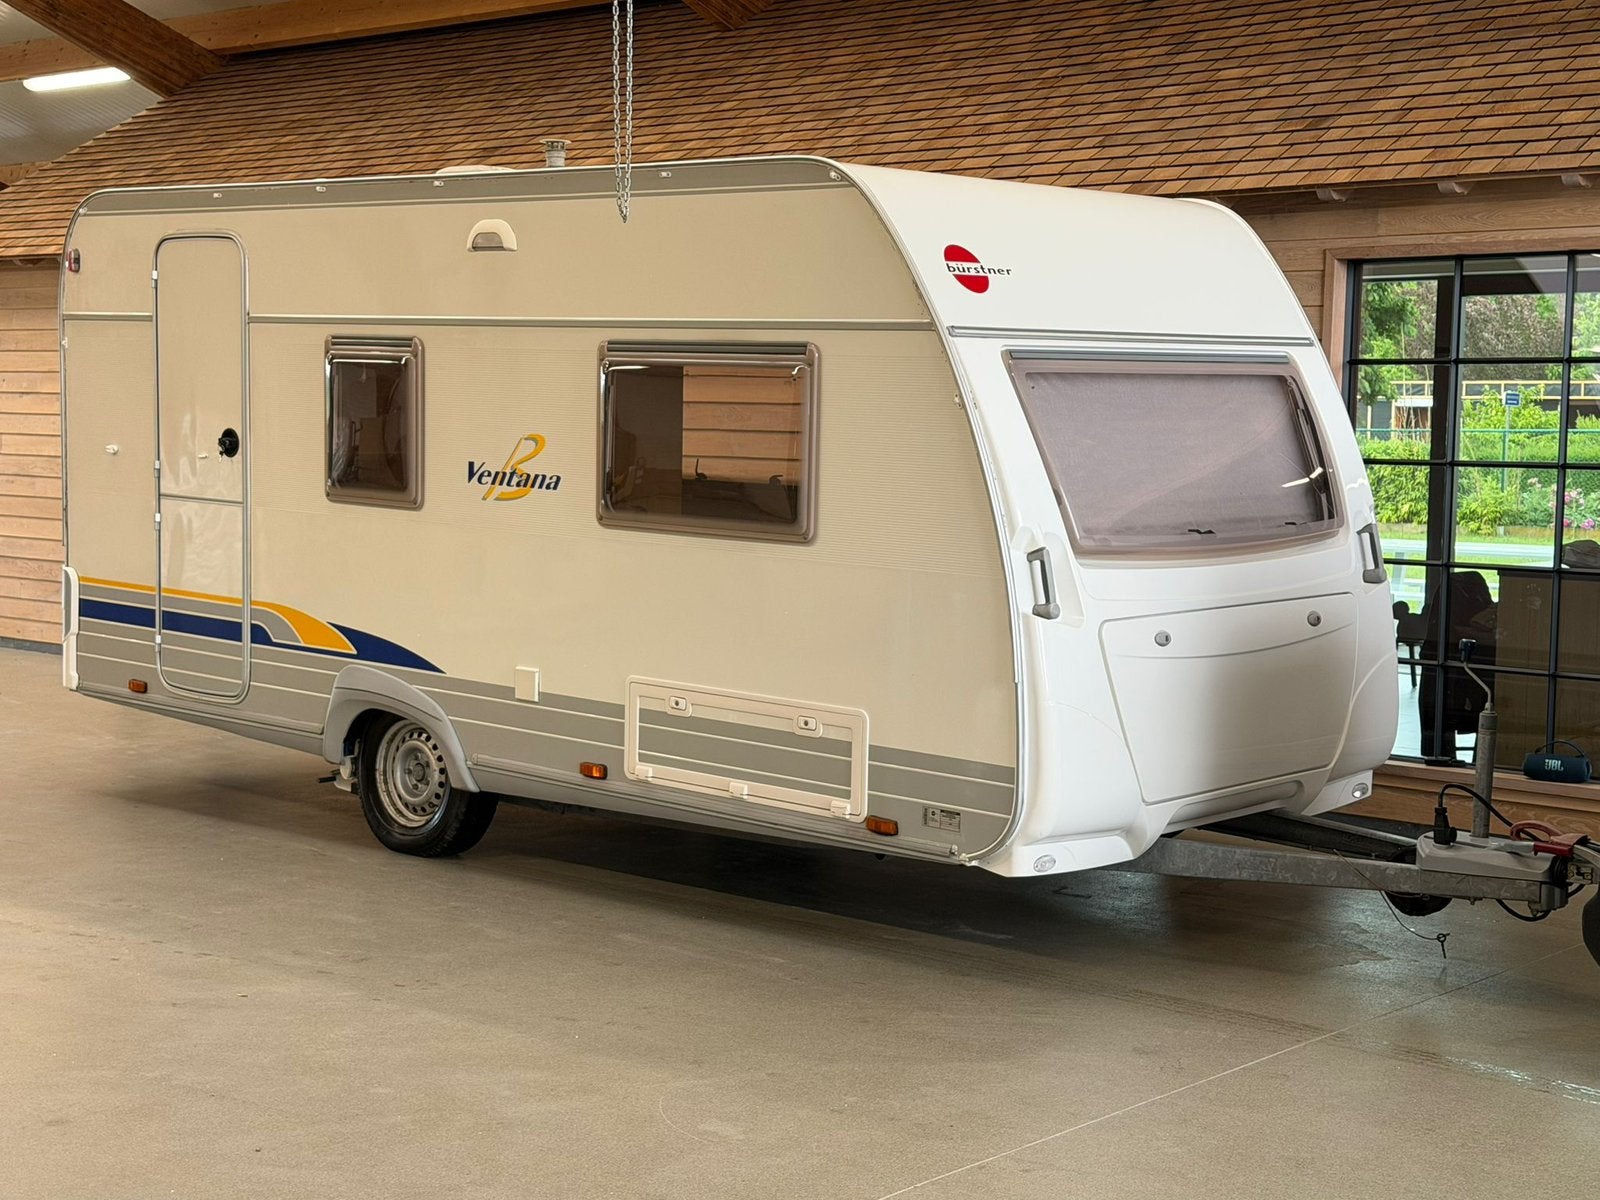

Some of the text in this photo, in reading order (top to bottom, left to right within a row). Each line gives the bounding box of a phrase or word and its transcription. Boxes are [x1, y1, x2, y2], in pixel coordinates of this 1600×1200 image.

[945, 262, 1012, 275] bürstner
[467, 460, 562, 491] Ventana
[1544, 758, 1564, 771] JBL
